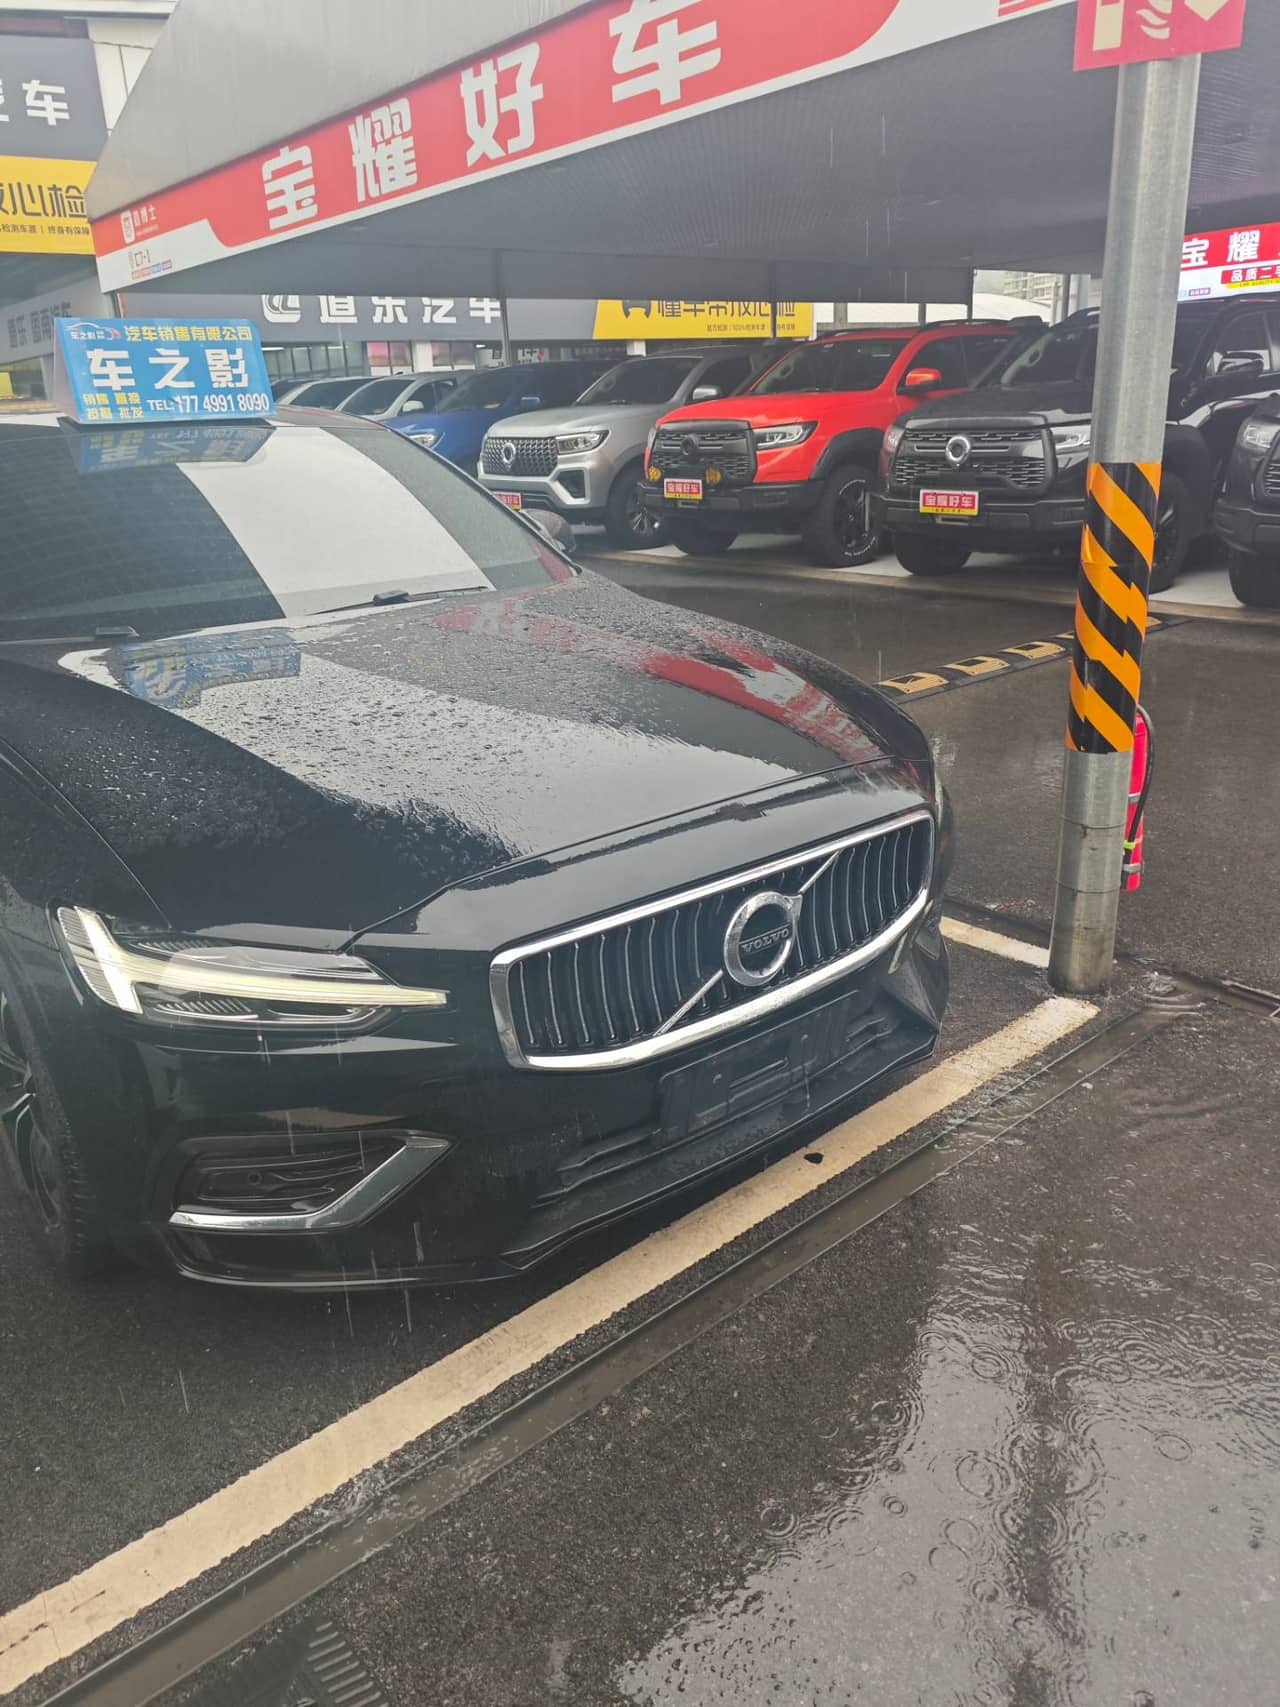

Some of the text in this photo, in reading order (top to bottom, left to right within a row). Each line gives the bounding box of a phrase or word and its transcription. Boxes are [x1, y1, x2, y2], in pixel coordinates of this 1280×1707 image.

[0, 79, 70, 126] 车
[262, 0, 722, 230] 宝耀好车
[0, 182, 88, 218] 心检
[1181, 230, 1280, 268] 宝耀
[124, 326, 253, 342] 汽车销售有限公司
[87, 348, 249, 391] 车之影
[203, 395, 235, 412] 4991
[240, 393, 270, 411] 8090
[740, 928, 790, 953] VOLVO
